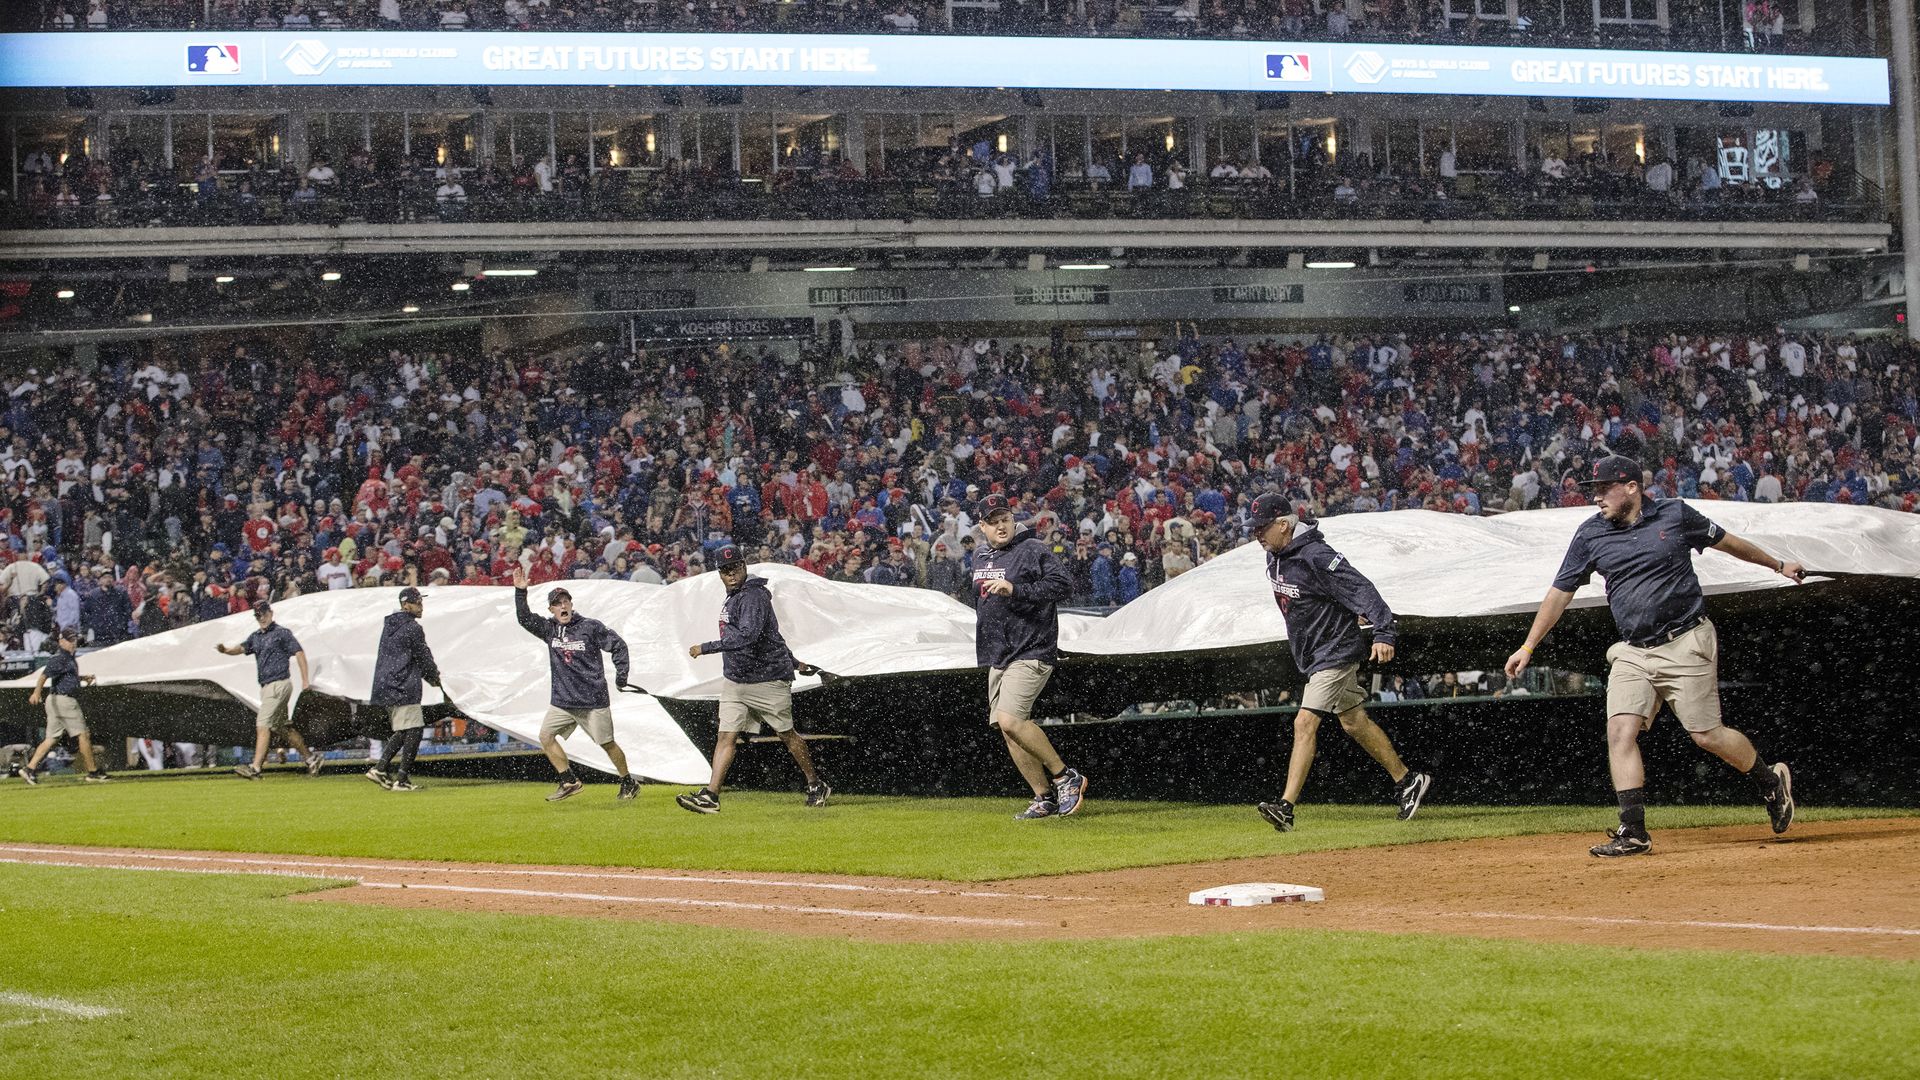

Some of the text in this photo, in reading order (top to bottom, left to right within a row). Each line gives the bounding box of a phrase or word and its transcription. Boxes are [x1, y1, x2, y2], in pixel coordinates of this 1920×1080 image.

[482, 46, 877, 72] GREAT FUTURES START HERE.
[1511, 60, 1830, 91] GREAT FUTURES START HERE.
[1032, 287, 1095, 302] BOB LEMON
[680, 321, 770, 335] KOSHER DOGS
[988, 497, 997, 506] C
[1251, 501, 1260, 513] C
[724, 549, 733, 559] C
